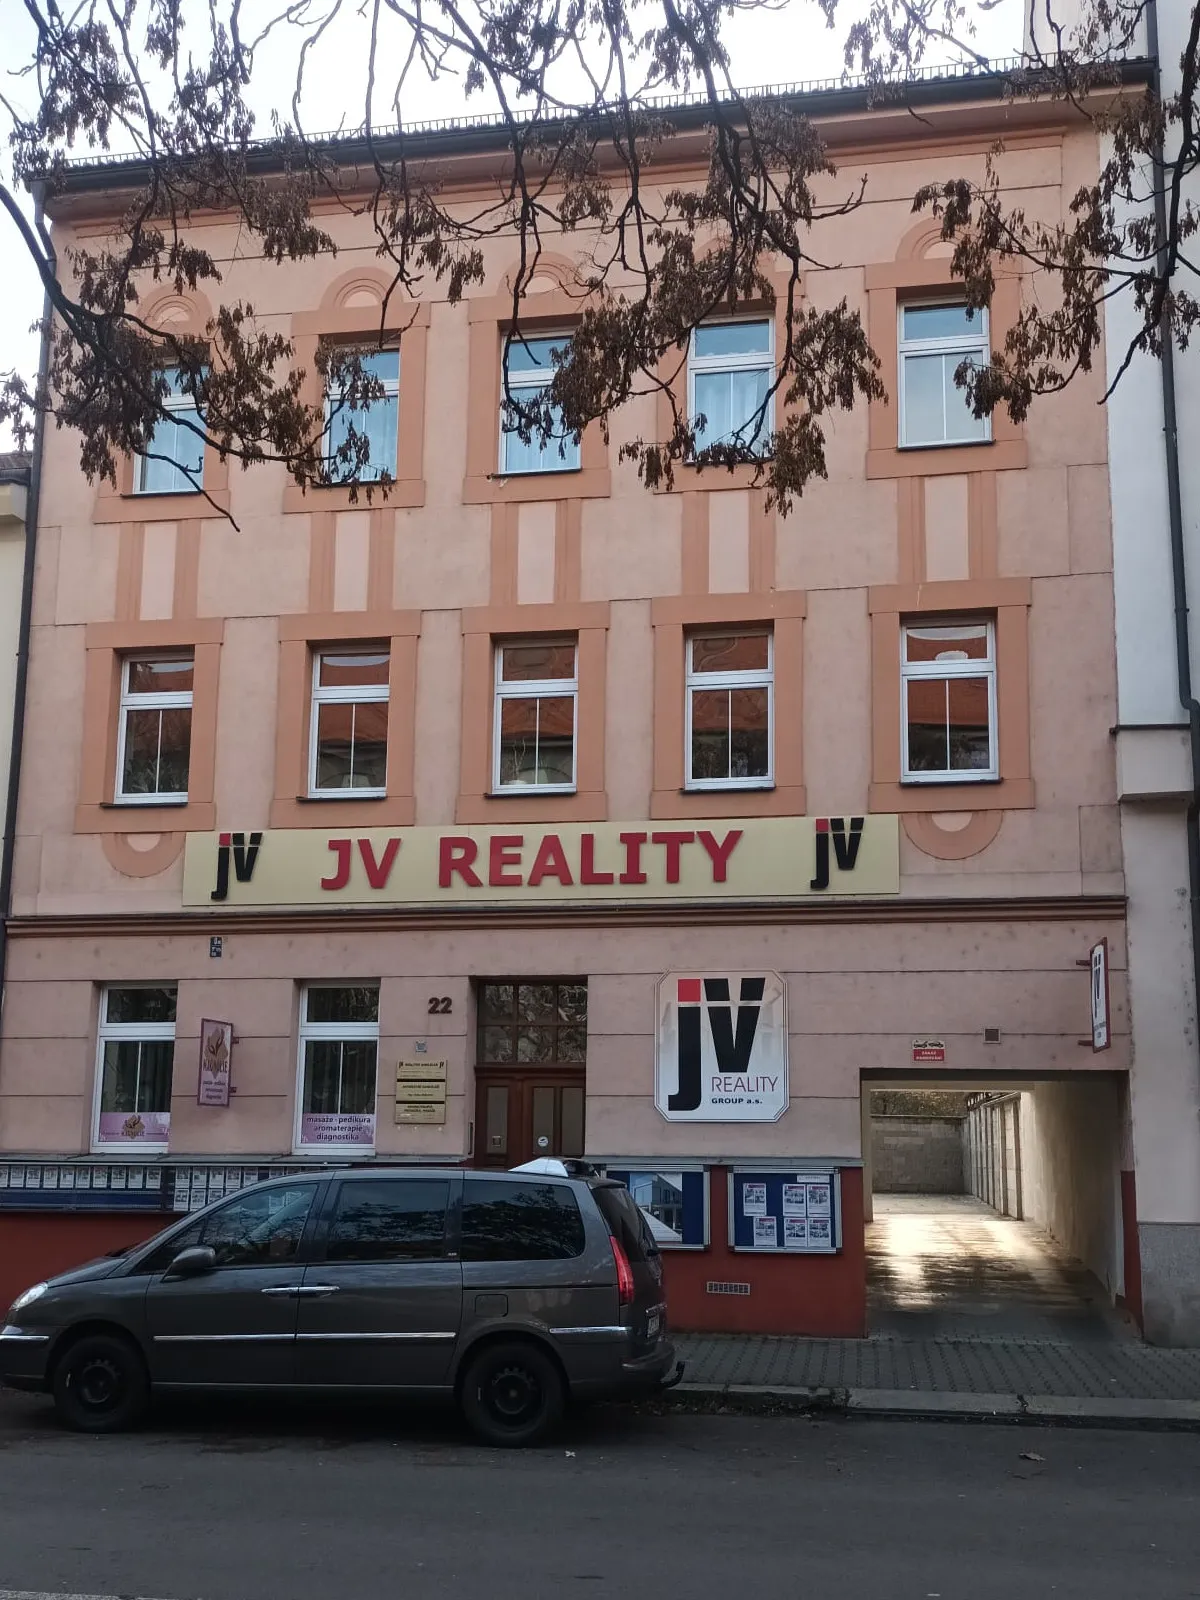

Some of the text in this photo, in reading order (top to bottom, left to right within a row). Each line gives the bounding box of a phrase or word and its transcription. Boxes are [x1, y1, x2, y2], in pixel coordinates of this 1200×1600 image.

[321, 830, 744, 891] JV REALITY
[428, 996, 453, 1015] 22
[711, 1076, 779, 1093] REALITY
[711, 1097, 763, 1105] GROUP a.s.
[313, 1125, 363, 1133] aromaterapie
[316, 1132, 360, 1141] diagnostika
